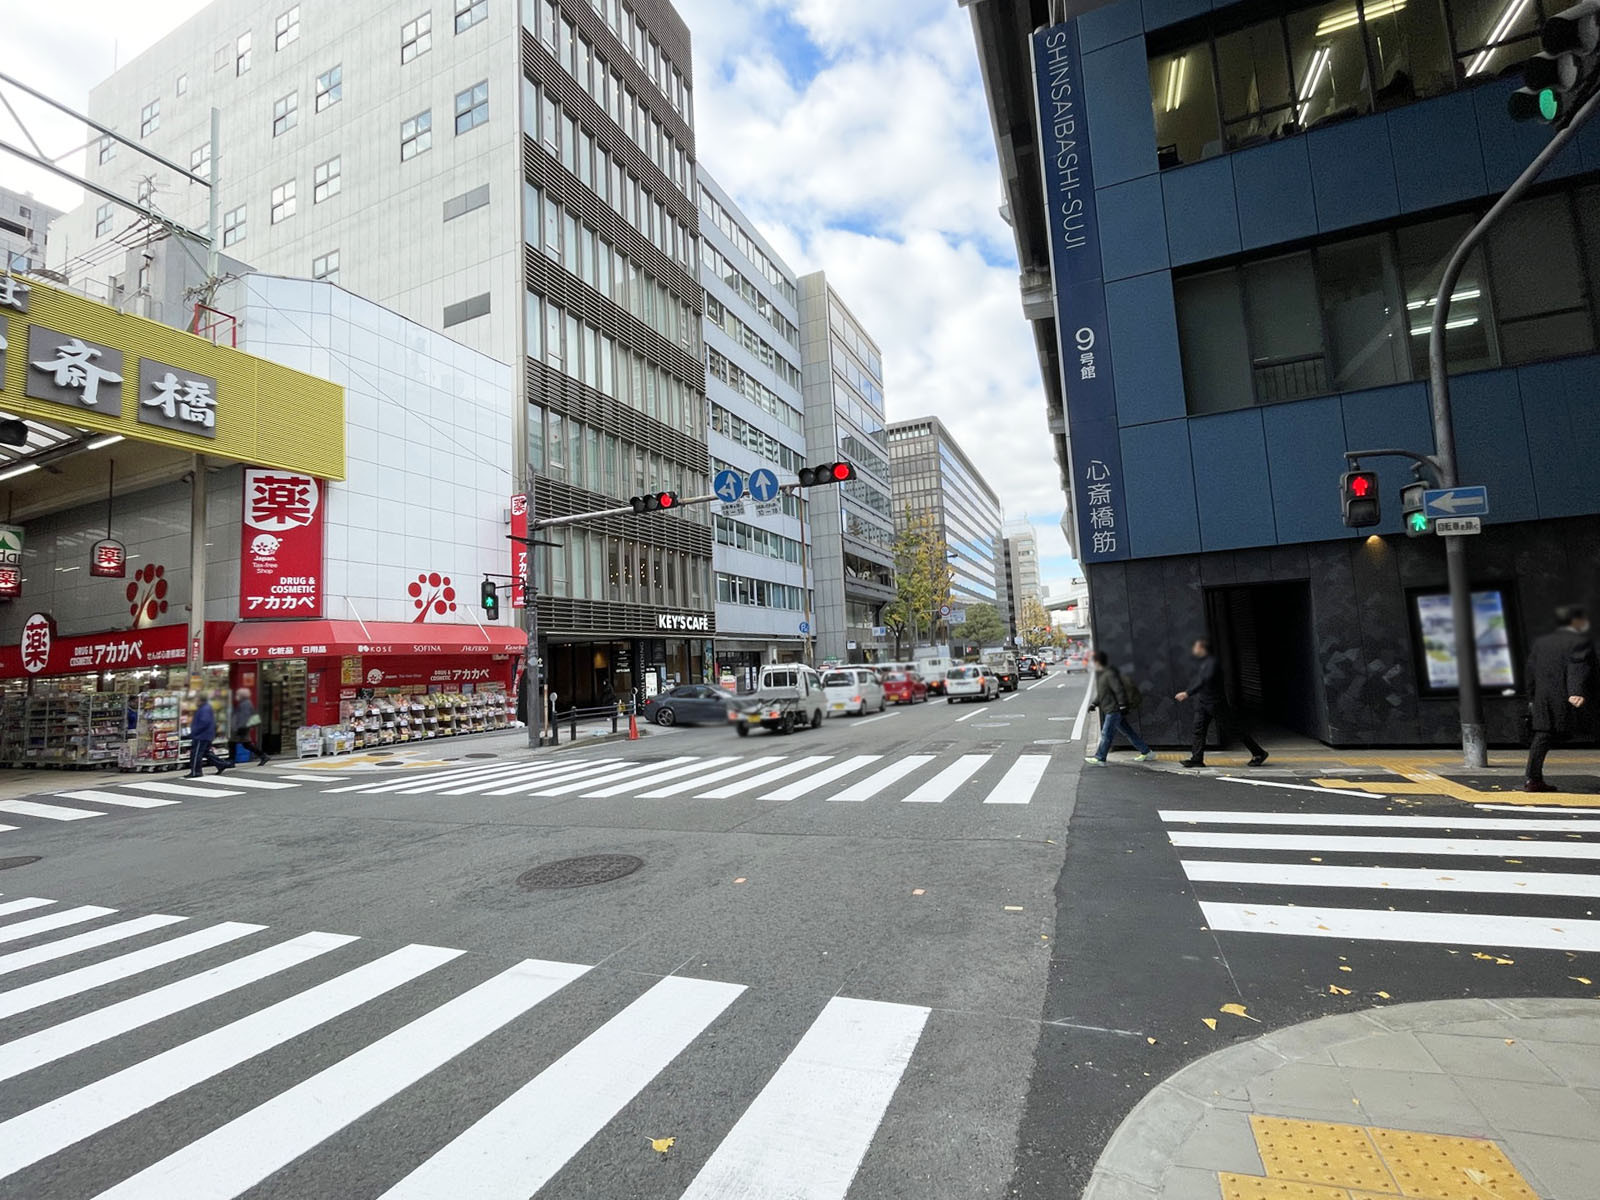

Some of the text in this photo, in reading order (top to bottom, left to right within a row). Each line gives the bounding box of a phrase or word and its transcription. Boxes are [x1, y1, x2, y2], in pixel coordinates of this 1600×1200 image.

[1046, 31, 1086, 250] SHINSAIBASHI-SUJI
[1075, 327, 1096, 380] 9号館
[0, 335, 218, 428] 斎橋
[252, 475, 311, 525] 薬
[1086, 459, 1117, 554] 心斎橋筋
[280, 576, 315, 584] DRUG &
[270, 585, 315, 594] COSMETIC
[247, 595, 315, 610] アカカベ
[659, 614, 709, 631] KEY'S CAFÉ
[25, 621, 49, 667] 薬
[94, 640, 143, 665] アカカベ
[234, 647, 259, 655] くすり
[268, 646, 294, 655] 化粧品
[302, 645, 327, 654] 日用品
[452, 668, 490, 681] アカカベ
